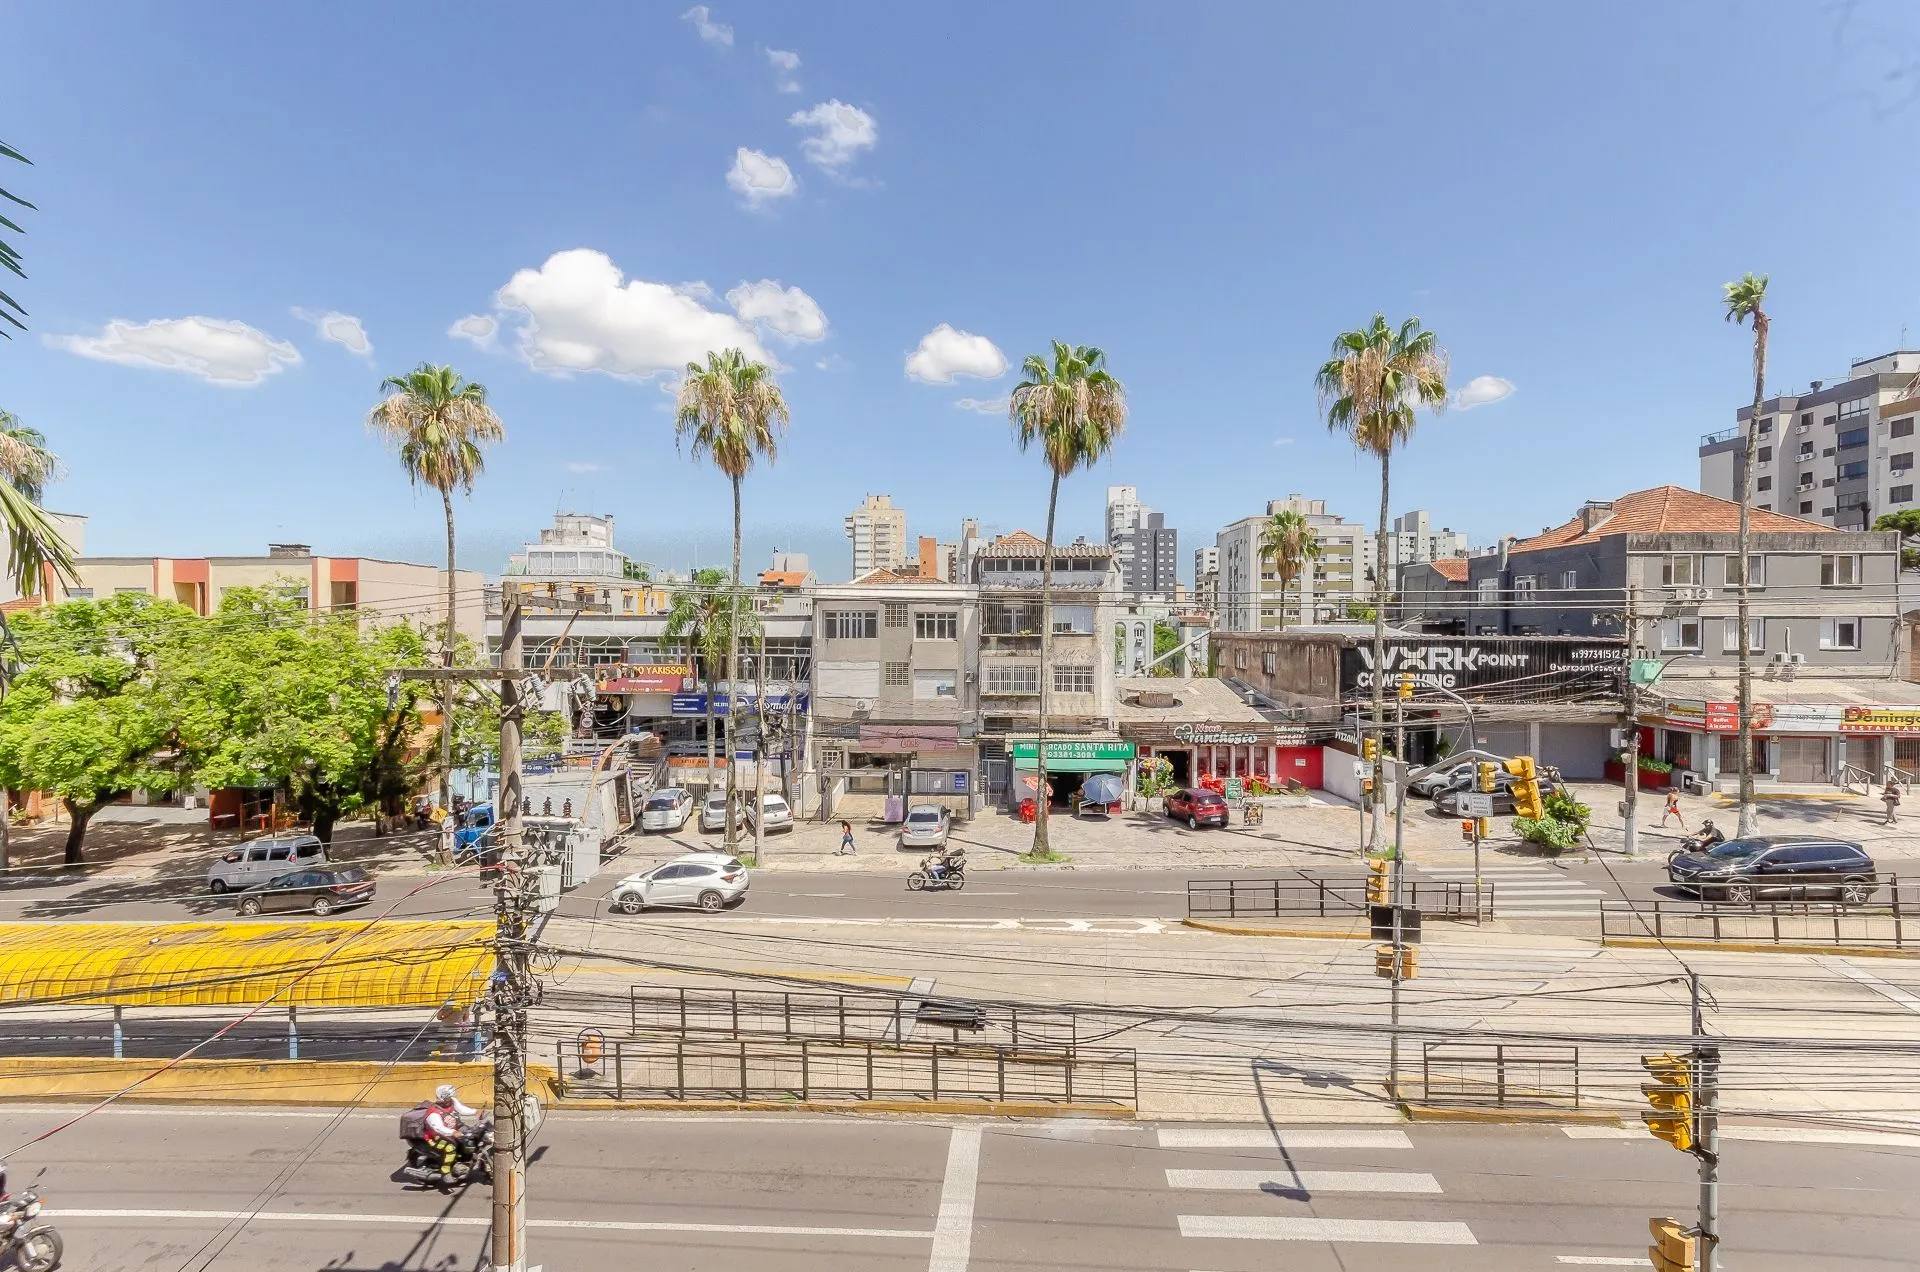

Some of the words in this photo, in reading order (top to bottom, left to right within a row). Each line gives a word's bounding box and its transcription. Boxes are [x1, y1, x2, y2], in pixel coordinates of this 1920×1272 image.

[1477, 654, 1529, 667] POINT
[1045, 743, 1073, 751] RCADO
[1074, 742, 1105, 751] SANTA
[1107, 743, 1129, 751] RITA
